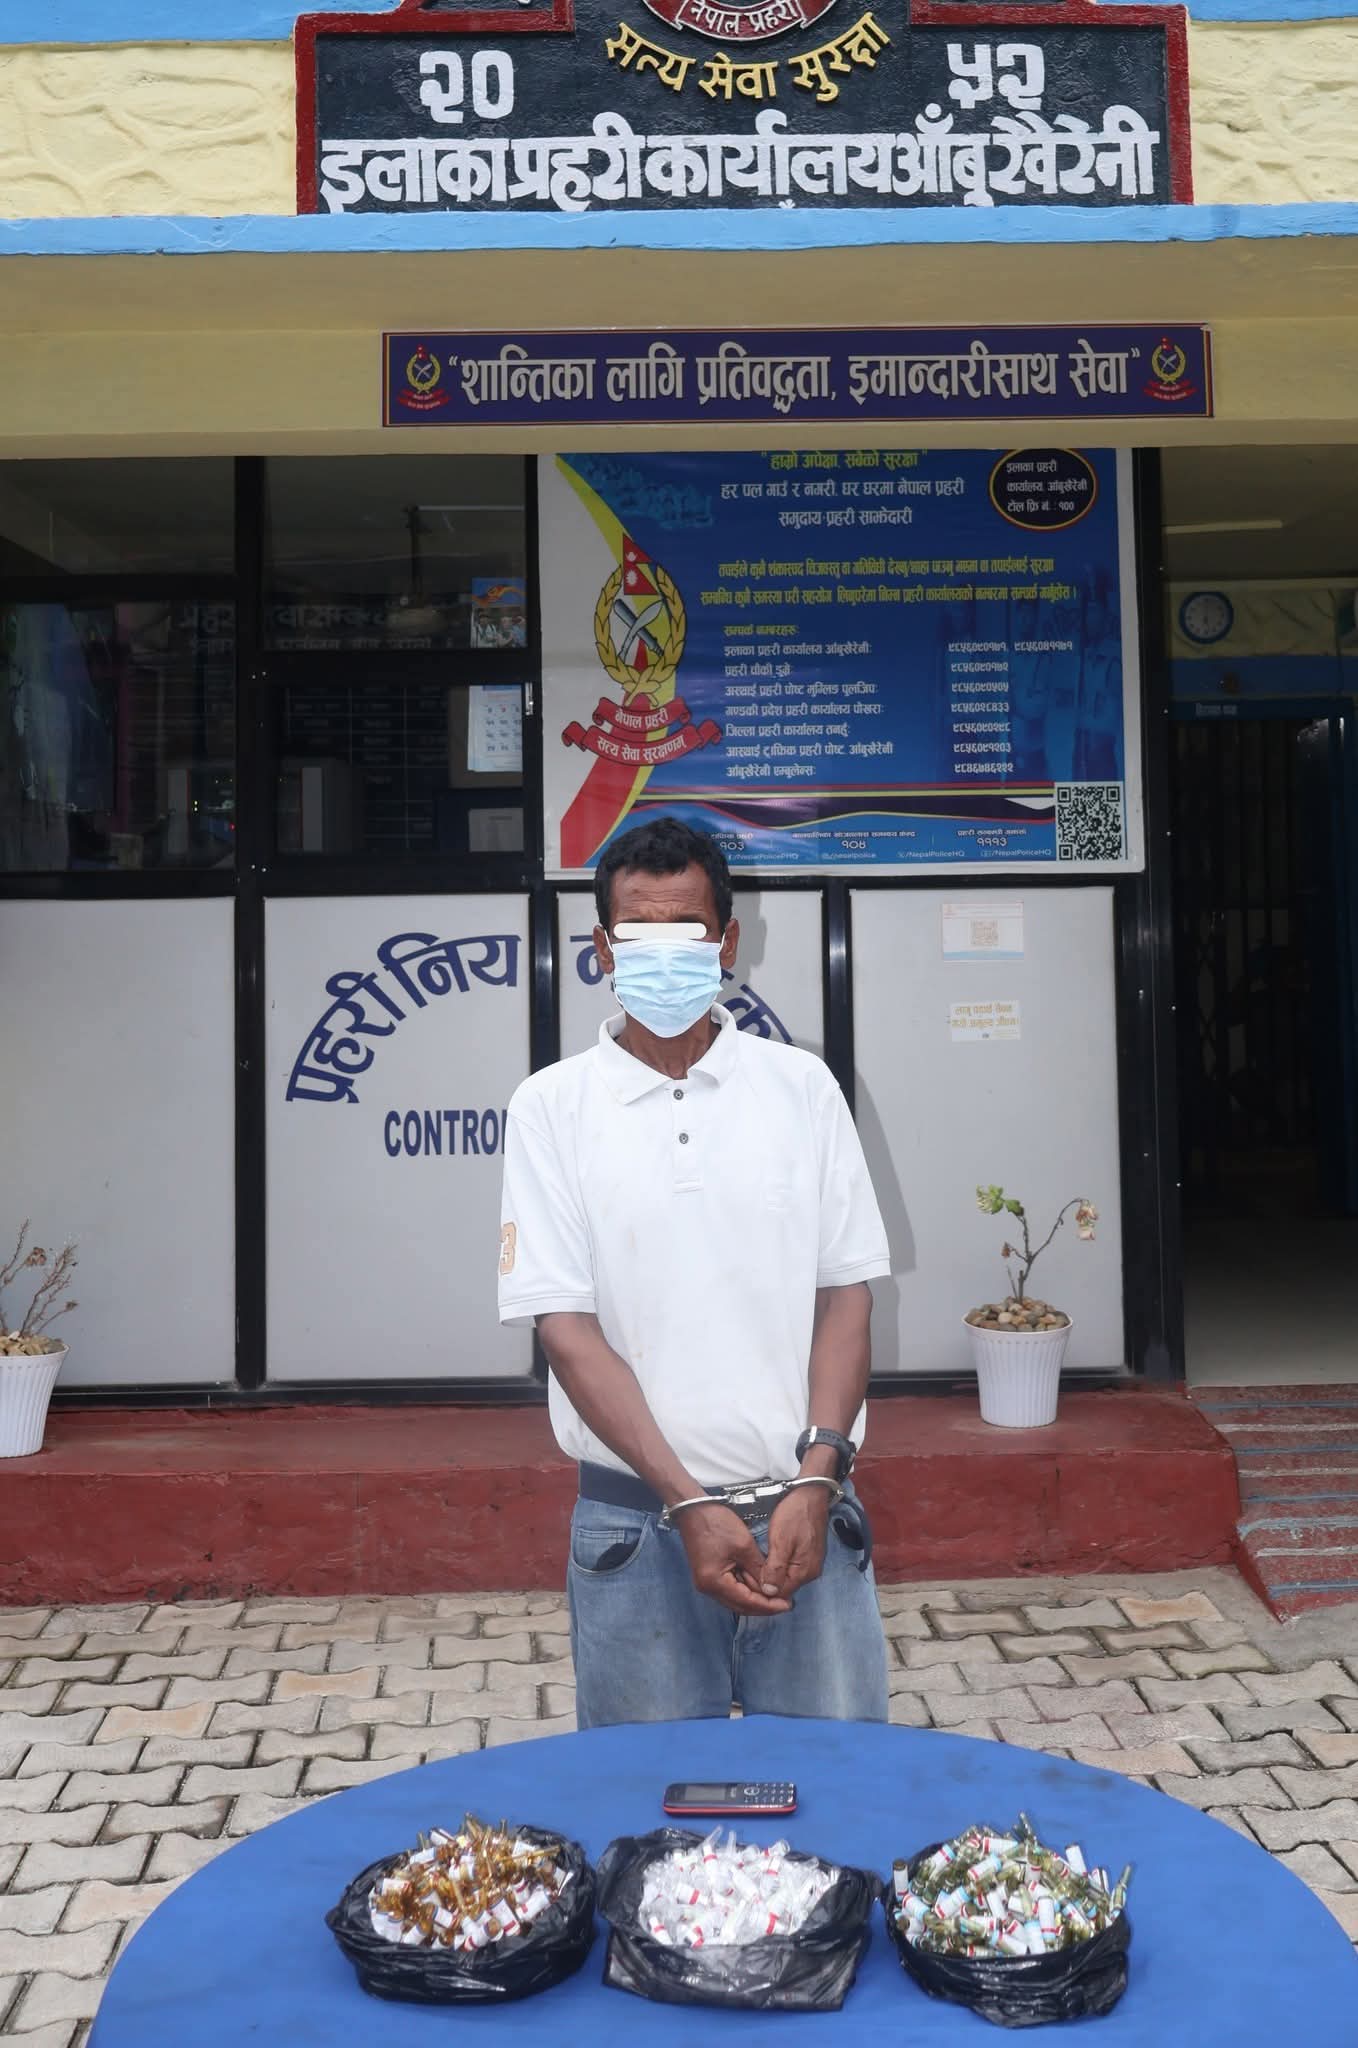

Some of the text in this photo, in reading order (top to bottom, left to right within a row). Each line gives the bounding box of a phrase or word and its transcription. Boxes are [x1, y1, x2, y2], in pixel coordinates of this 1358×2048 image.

[605, 11, 891, 101] सत्य सेवा सुरक्षा
[947, 43, 1045, 110] ५२
[419, 50, 515, 123] २०
[320, 137, 510, 213] इलाका
[508, 111, 646, 212] प्रहरी
[645, 109, 896, 198] कार्यालय
[606, 342, 686, 402] लागि
[848, 340, 1059, 405] इमान्दारीसाथ
[1006, 458, 1058, 474] इलाका प्रहरी
[720, 483, 738, 500] हर
[897, 477, 931, 496] नेपाल
[935, 476, 965, 497] प्रहरी
[723, 644, 755, 657] इलाका
[757, 642, 781, 657] प्रहरी
[783, 642, 823, 656] कार्यालय
[725, 663, 747, 676] प्रहरी
[759, 682, 782, 697] प्रहरी
[785, 701, 808, 716] प्रहरी
[810, 701, 851, 715] कार्यालय
[614, 708, 669, 729] नेपाल प्रहरी
[725, 722, 756, 737] जिल्ला
[758, 722, 781, 737] प्रहरी
[783, 721, 824, 736] कार्यालय
[597, 735, 619, 758] सत्य
[621, 743, 641, 761] सेवा
[799, 741, 823, 757] प्रहरी
[719, 841, 745, 851] १०३
[977, 837, 1008, 847] १११३
[285, 971, 407, 1104] प्रहरी
